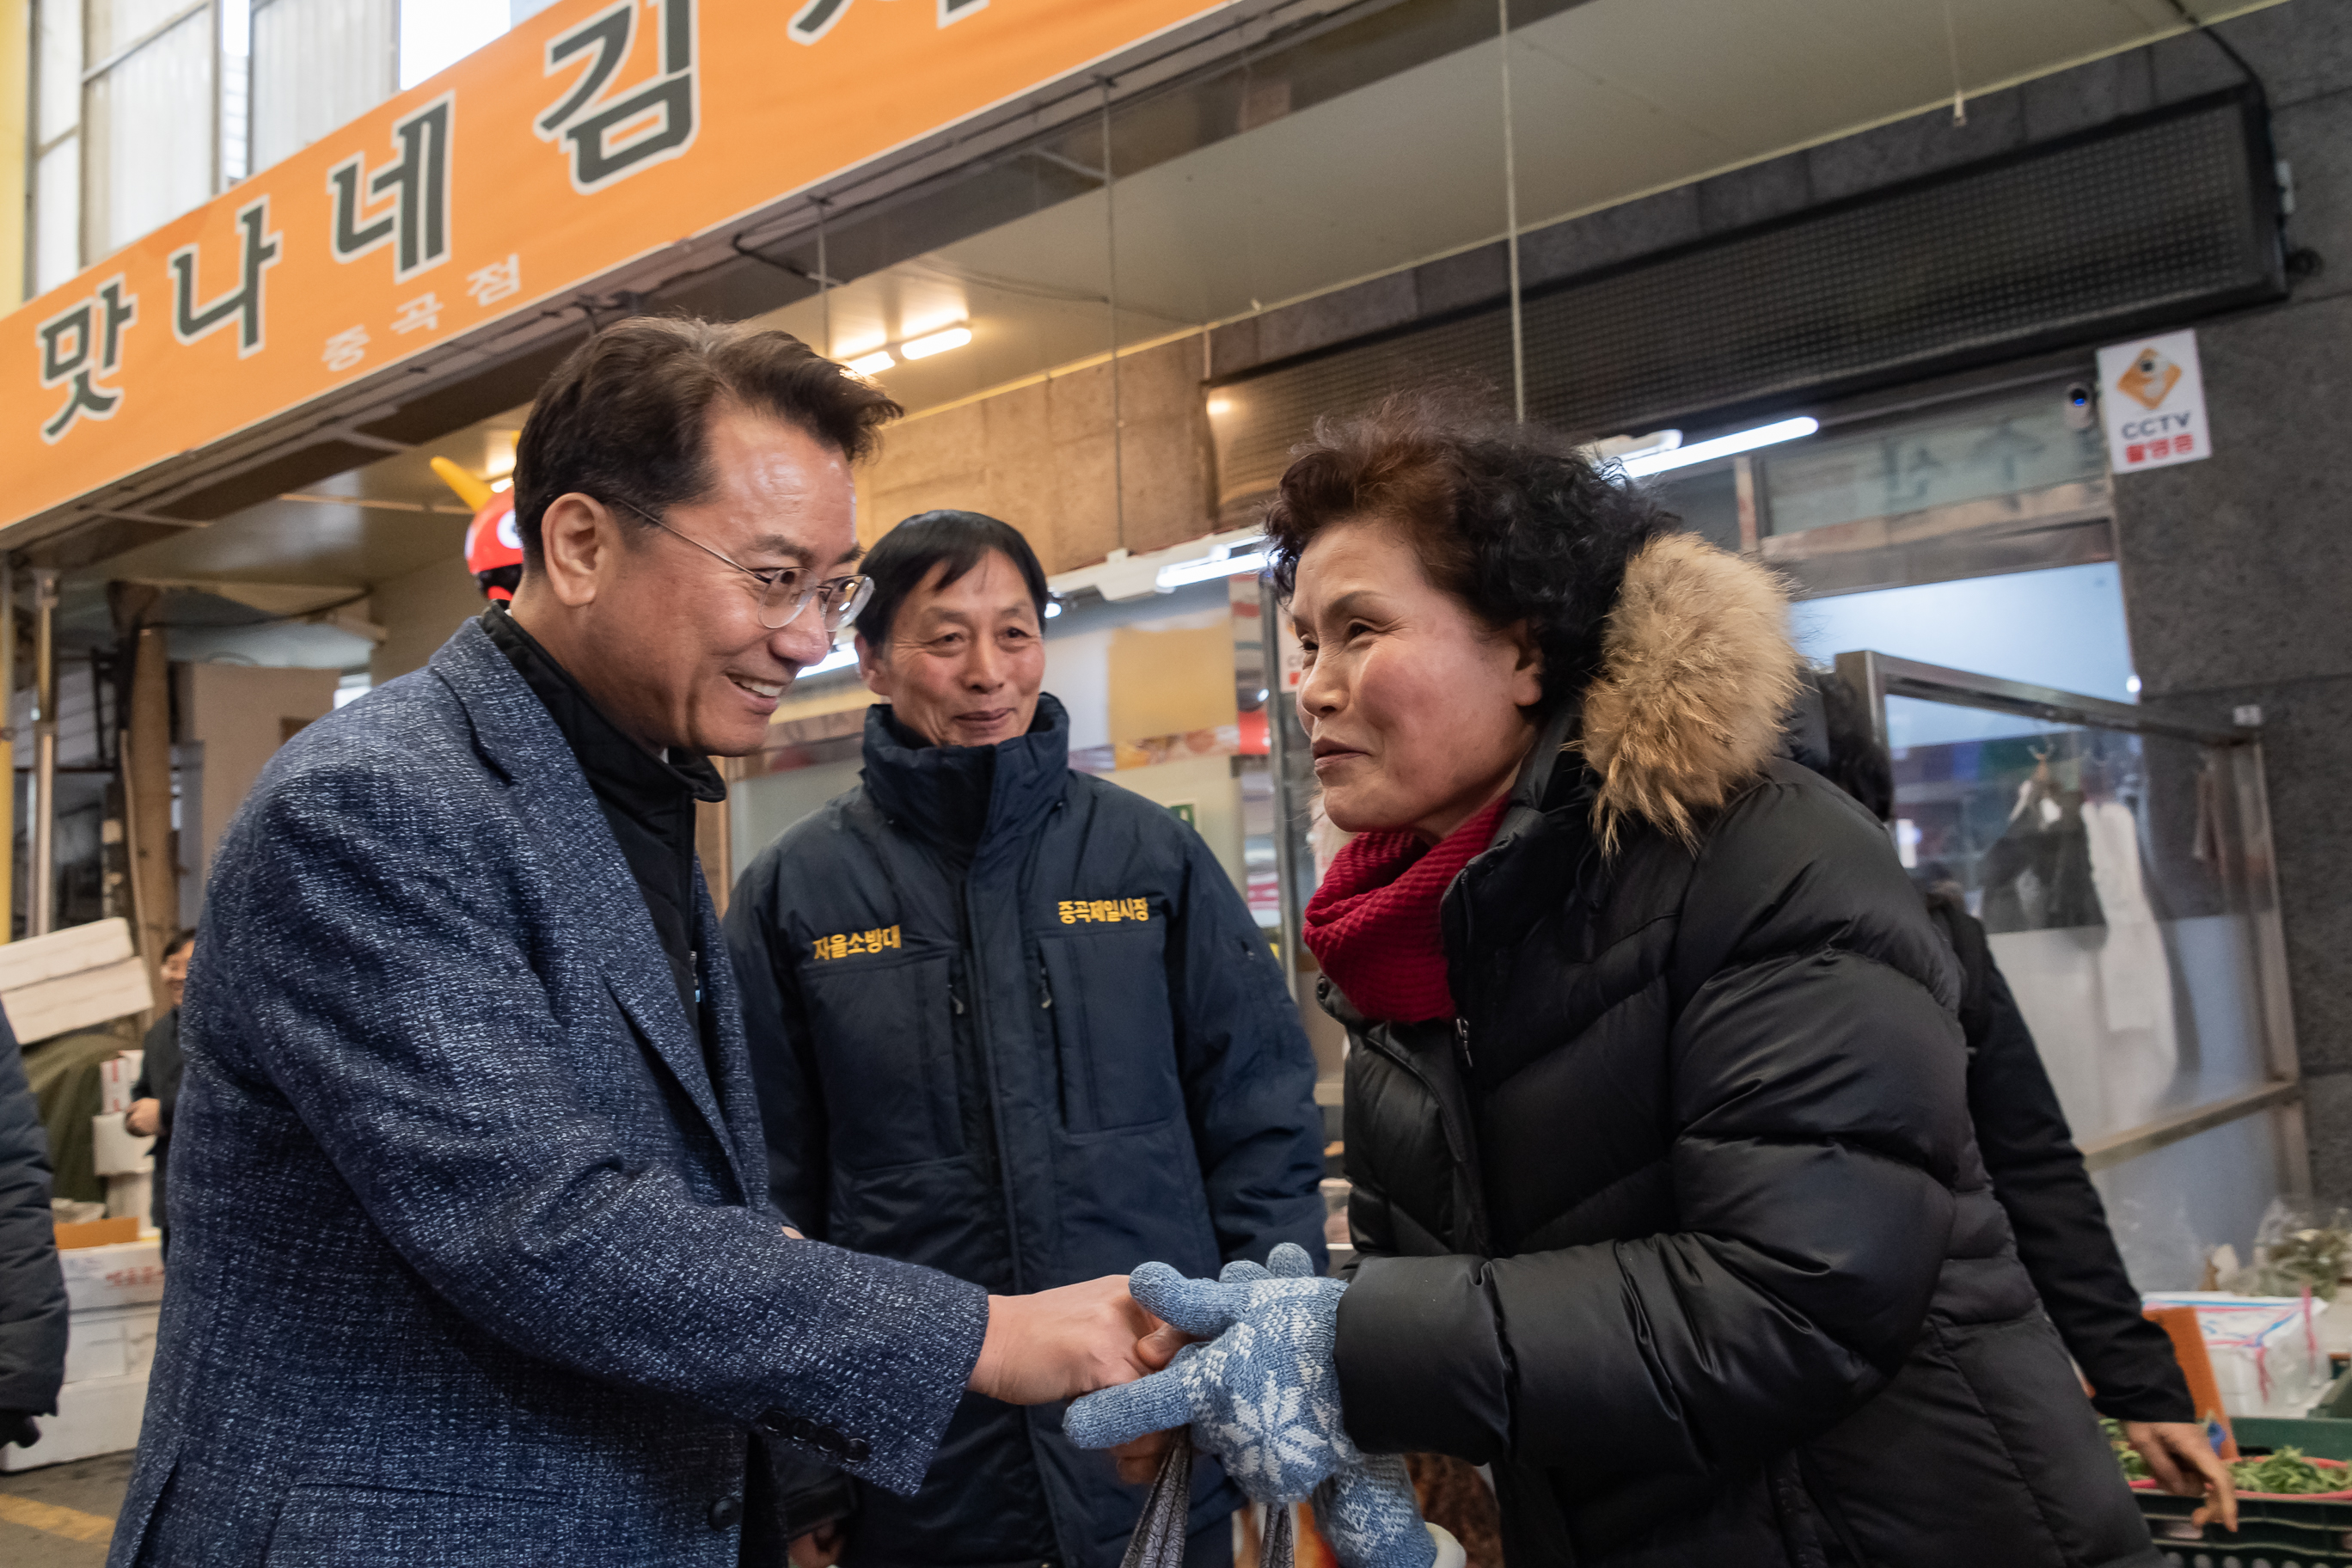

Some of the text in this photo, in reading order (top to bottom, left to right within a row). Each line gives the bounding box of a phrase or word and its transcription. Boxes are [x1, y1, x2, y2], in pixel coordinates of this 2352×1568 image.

[322, 253, 521, 372] 중곡점
[2121, 409, 2191, 440] CCTV
[1057, 897, 1149, 925] 중곡제일시장
